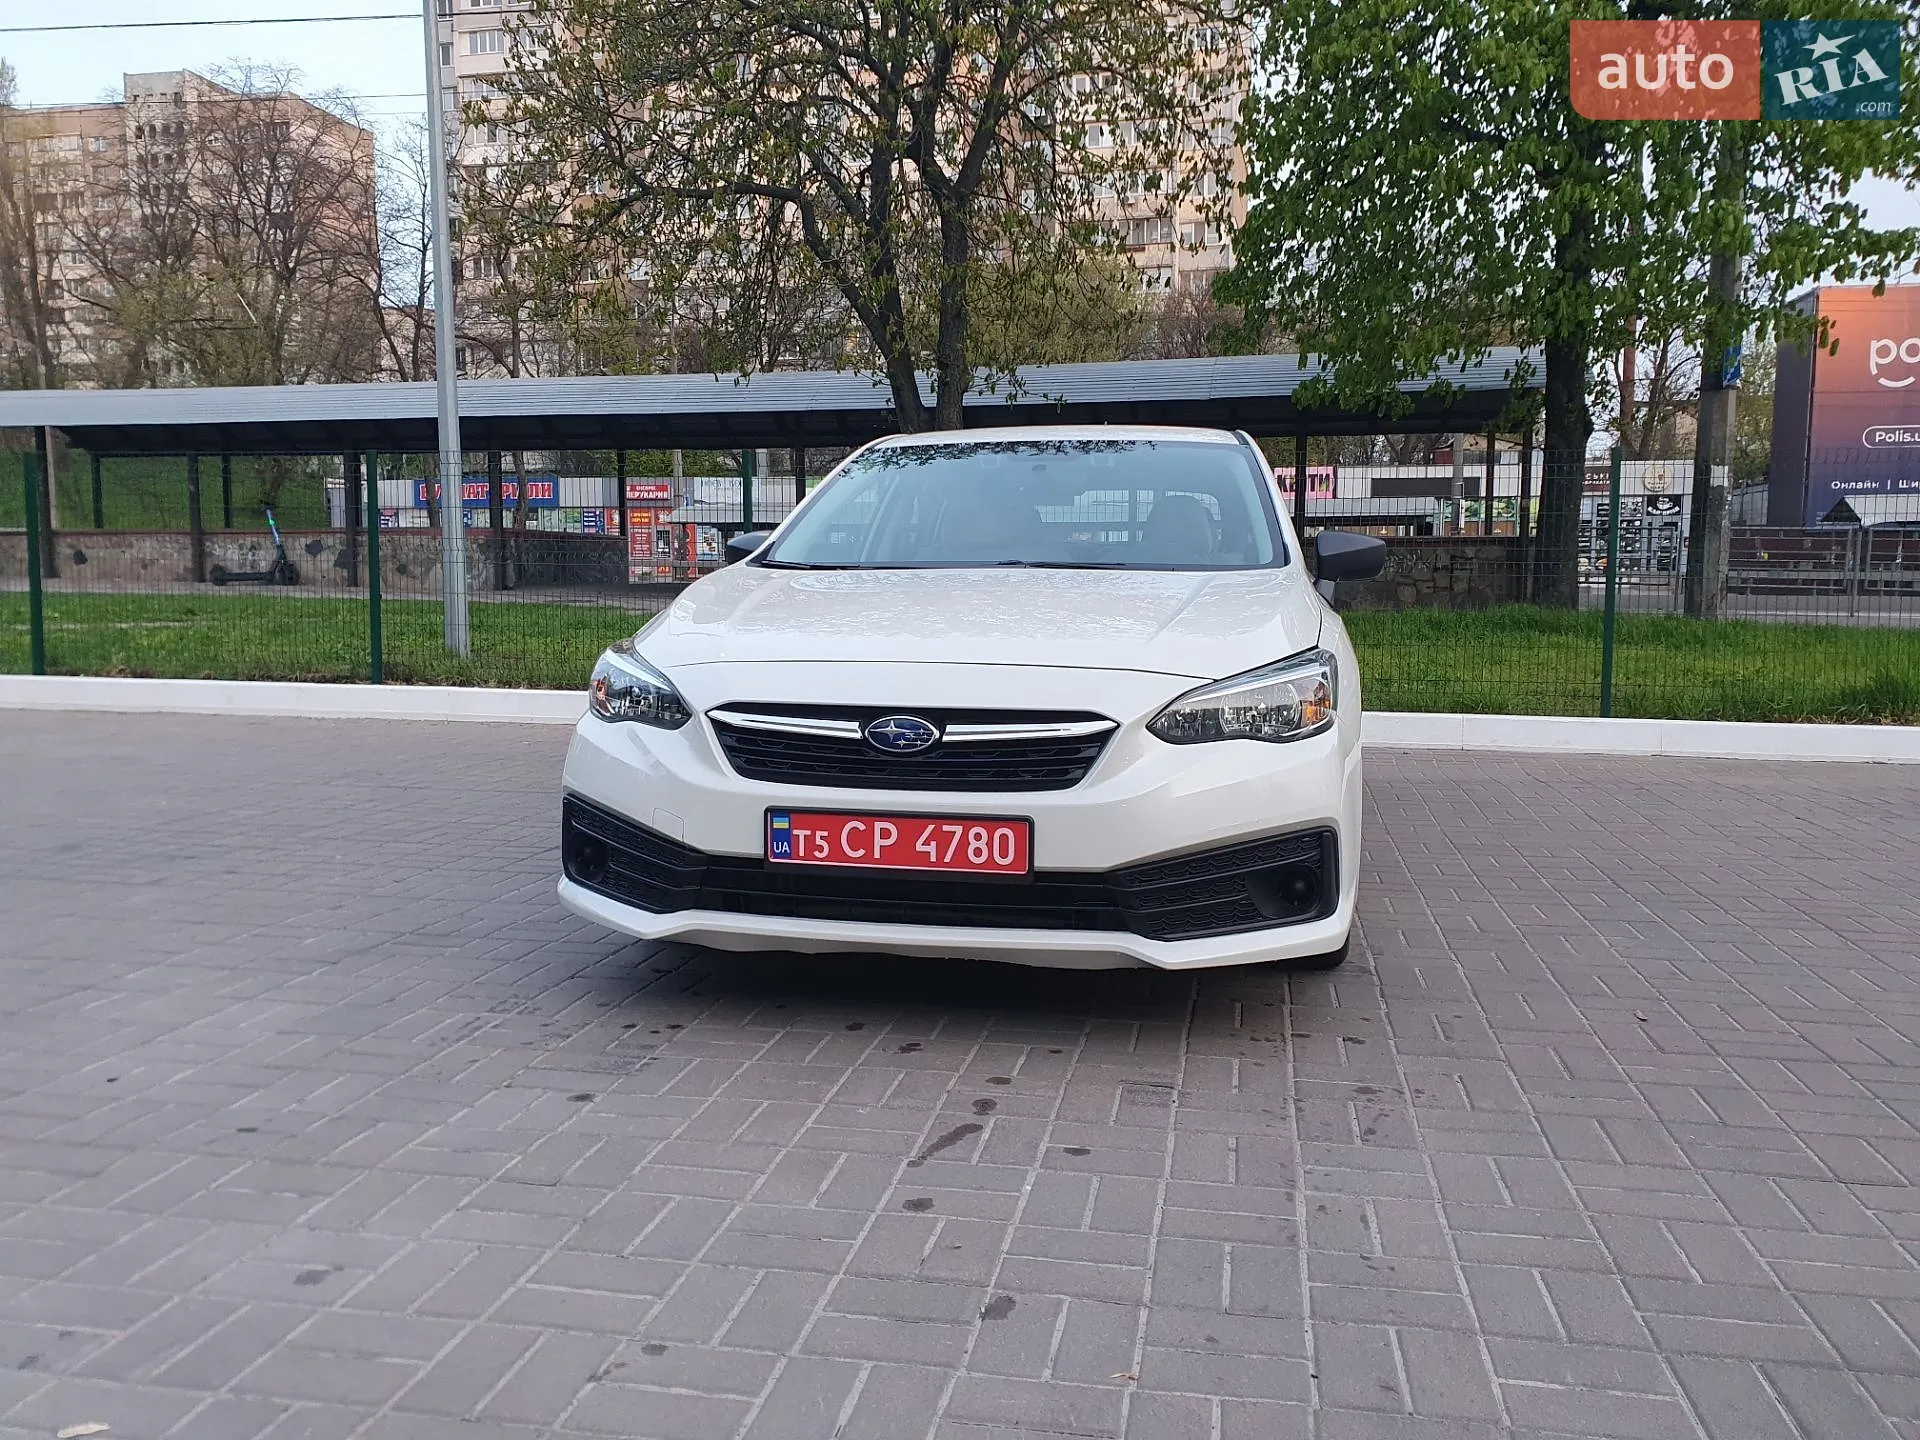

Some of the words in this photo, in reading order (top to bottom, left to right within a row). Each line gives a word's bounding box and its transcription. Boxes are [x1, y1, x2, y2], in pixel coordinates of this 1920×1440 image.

[1276, 473, 1331, 493] КВТИ
[1831, 479, 1880, 490] Онлайн
[1898, 479, 1920, 489] Ши
[773, 840, 790, 854] UA
[793, 828, 830, 859] T5
[840, 820, 898, 859] CP
[915, 823, 1015, 866] 4780
